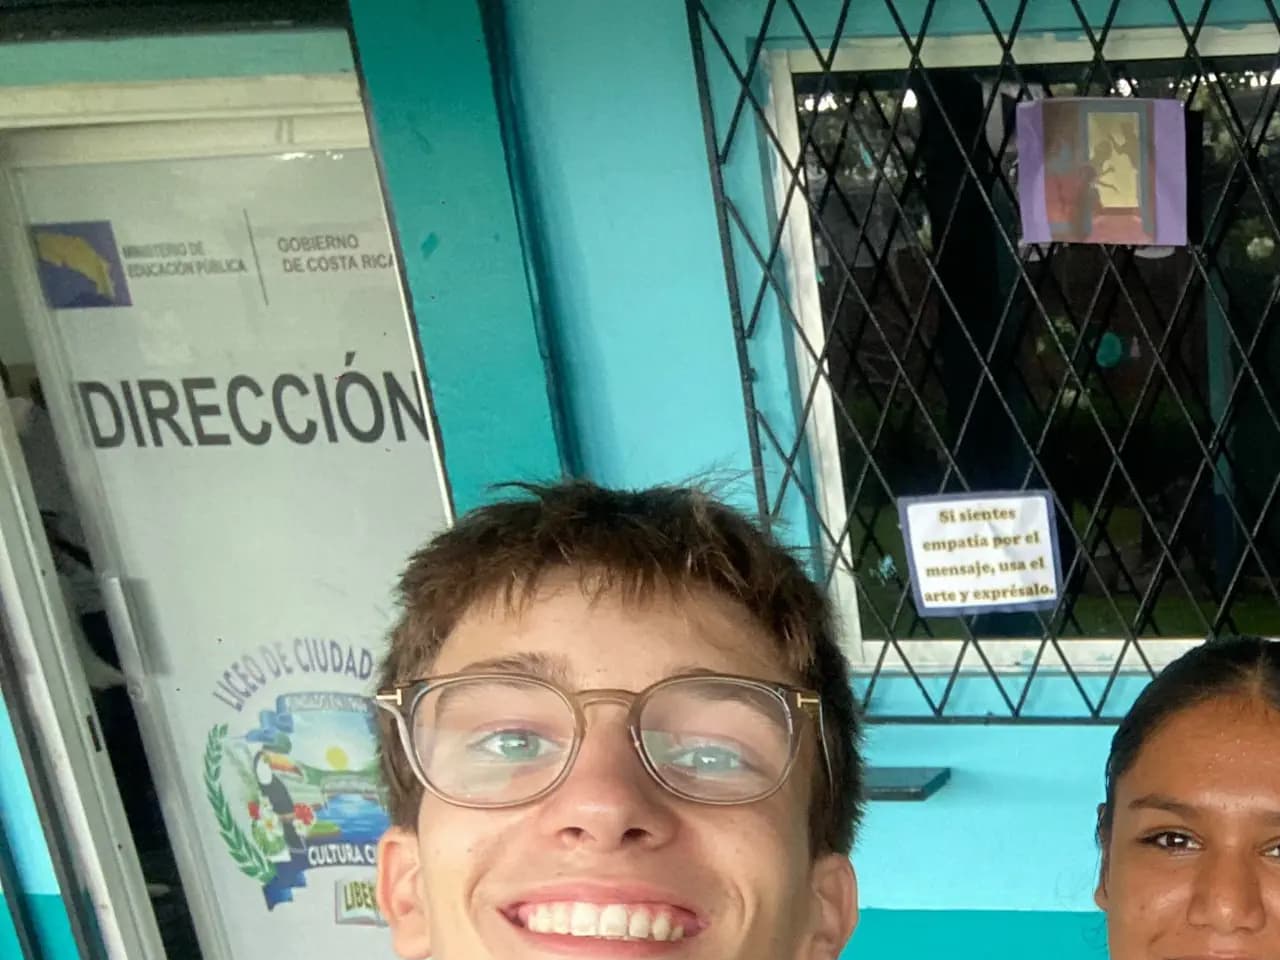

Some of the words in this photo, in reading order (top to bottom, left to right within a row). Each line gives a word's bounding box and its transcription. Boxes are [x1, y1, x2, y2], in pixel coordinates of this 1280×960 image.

[278, 233, 359, 252] GOBIERNO
[282, 257, 305, 273] DE
[306, 255, 358, 272] COSTA
[78, 351, 430, 449] DIRECCIÓN
[939, 509, 956, 524] Si
[960, 507, 1016, 522] sientes
[992, 534, 1022, 549] por
[1025, 531, 1040, 544] el
[926, 562, 996, 579] mensaje,
[1000, 560, 1026, 572] usa
[1029, 556, 1045, 569] el
[924, 589, 957, 603] arte
[959, 589, 969, 604] y
[213, 653, 266, 712] LICEO
[259, 641, 293, 678] DE
[294, 637, 374, 681] CIUDAD
[308, 843, 365, 866] CULTURA
